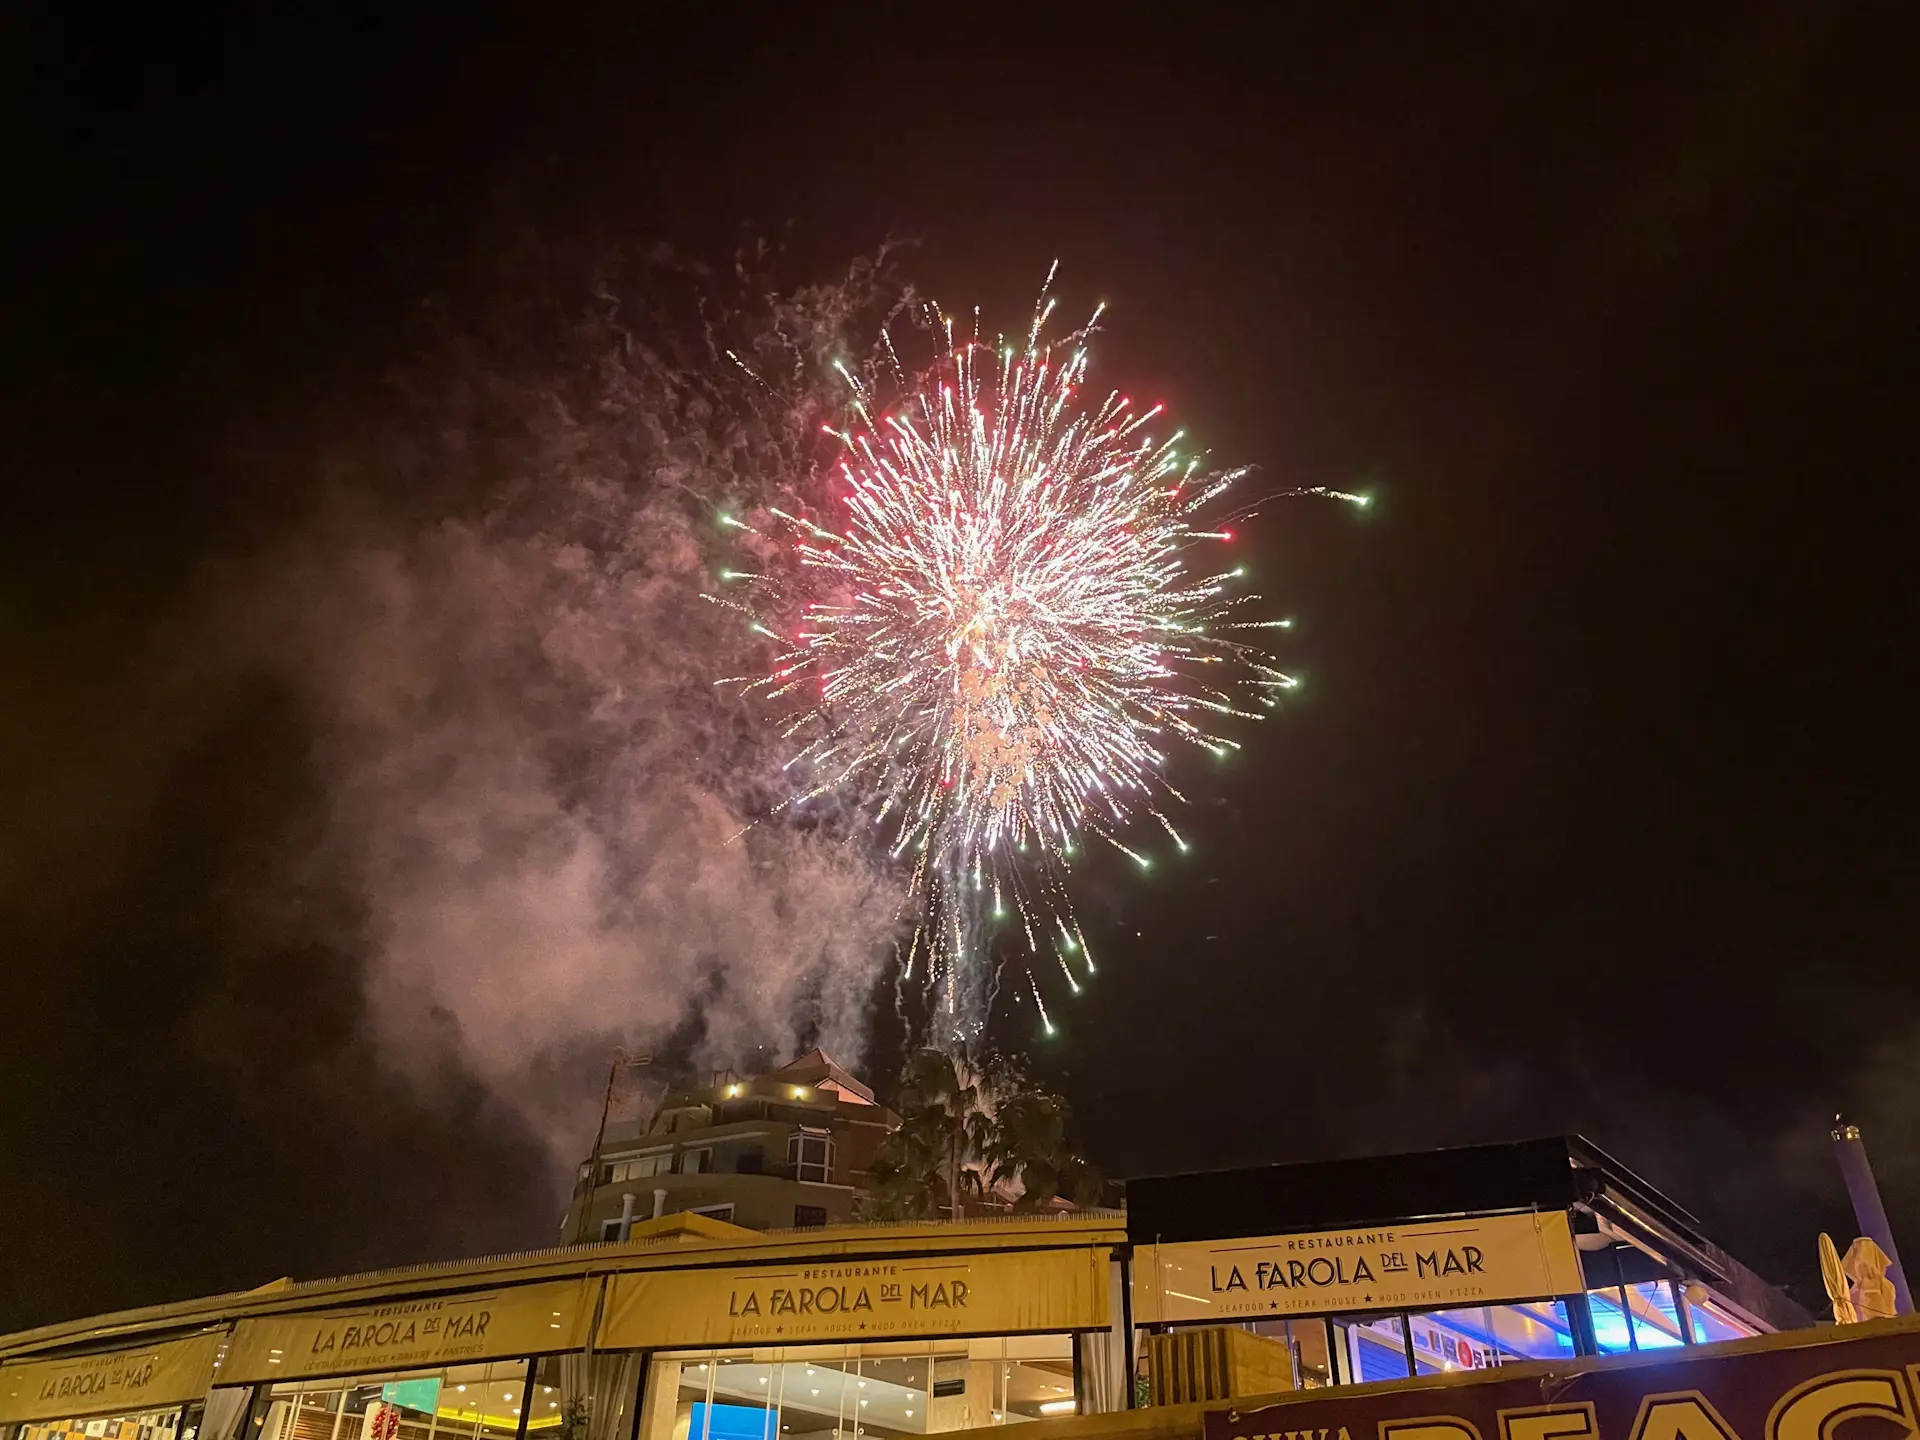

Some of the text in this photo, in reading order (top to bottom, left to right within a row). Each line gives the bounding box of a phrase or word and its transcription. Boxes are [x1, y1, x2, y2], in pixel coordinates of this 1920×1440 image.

[1288, 1232, 1395, 1250] RESTAURANTE
[804, 1266, 897, 1279] RESTAURANTE
[1211, 1246, 1487, 1293] LA FAROLA DEL MAR
[373, 1302, 443, 1317] RESTAURANTE
[728, 1280, 968, 1317] LA FAROLA DEL MAR
[1219, 1287, 1484, 1313] SEAFOOD STEAK HOUSE WOOD OVEN PIZZA
[312, 1310, 492, 1353] LA FAROLA DEL MAR
[731, 1326, 771, 1336] SEAFOOD
[789, 1324, 817, 1334] STEAK
[824, 1323, 853, 1332] HOUSE
[872, 1321, 895, 1330] WOOD
[902, 1319, 925, 1329] OVEN
[443, 1344, 484, 1357] PASTRIES
[39, 1379, 56, 1400] LA
[57, 1371, 108, 1399] FAROLA
[121, 1364, 153, 1389] MAR
